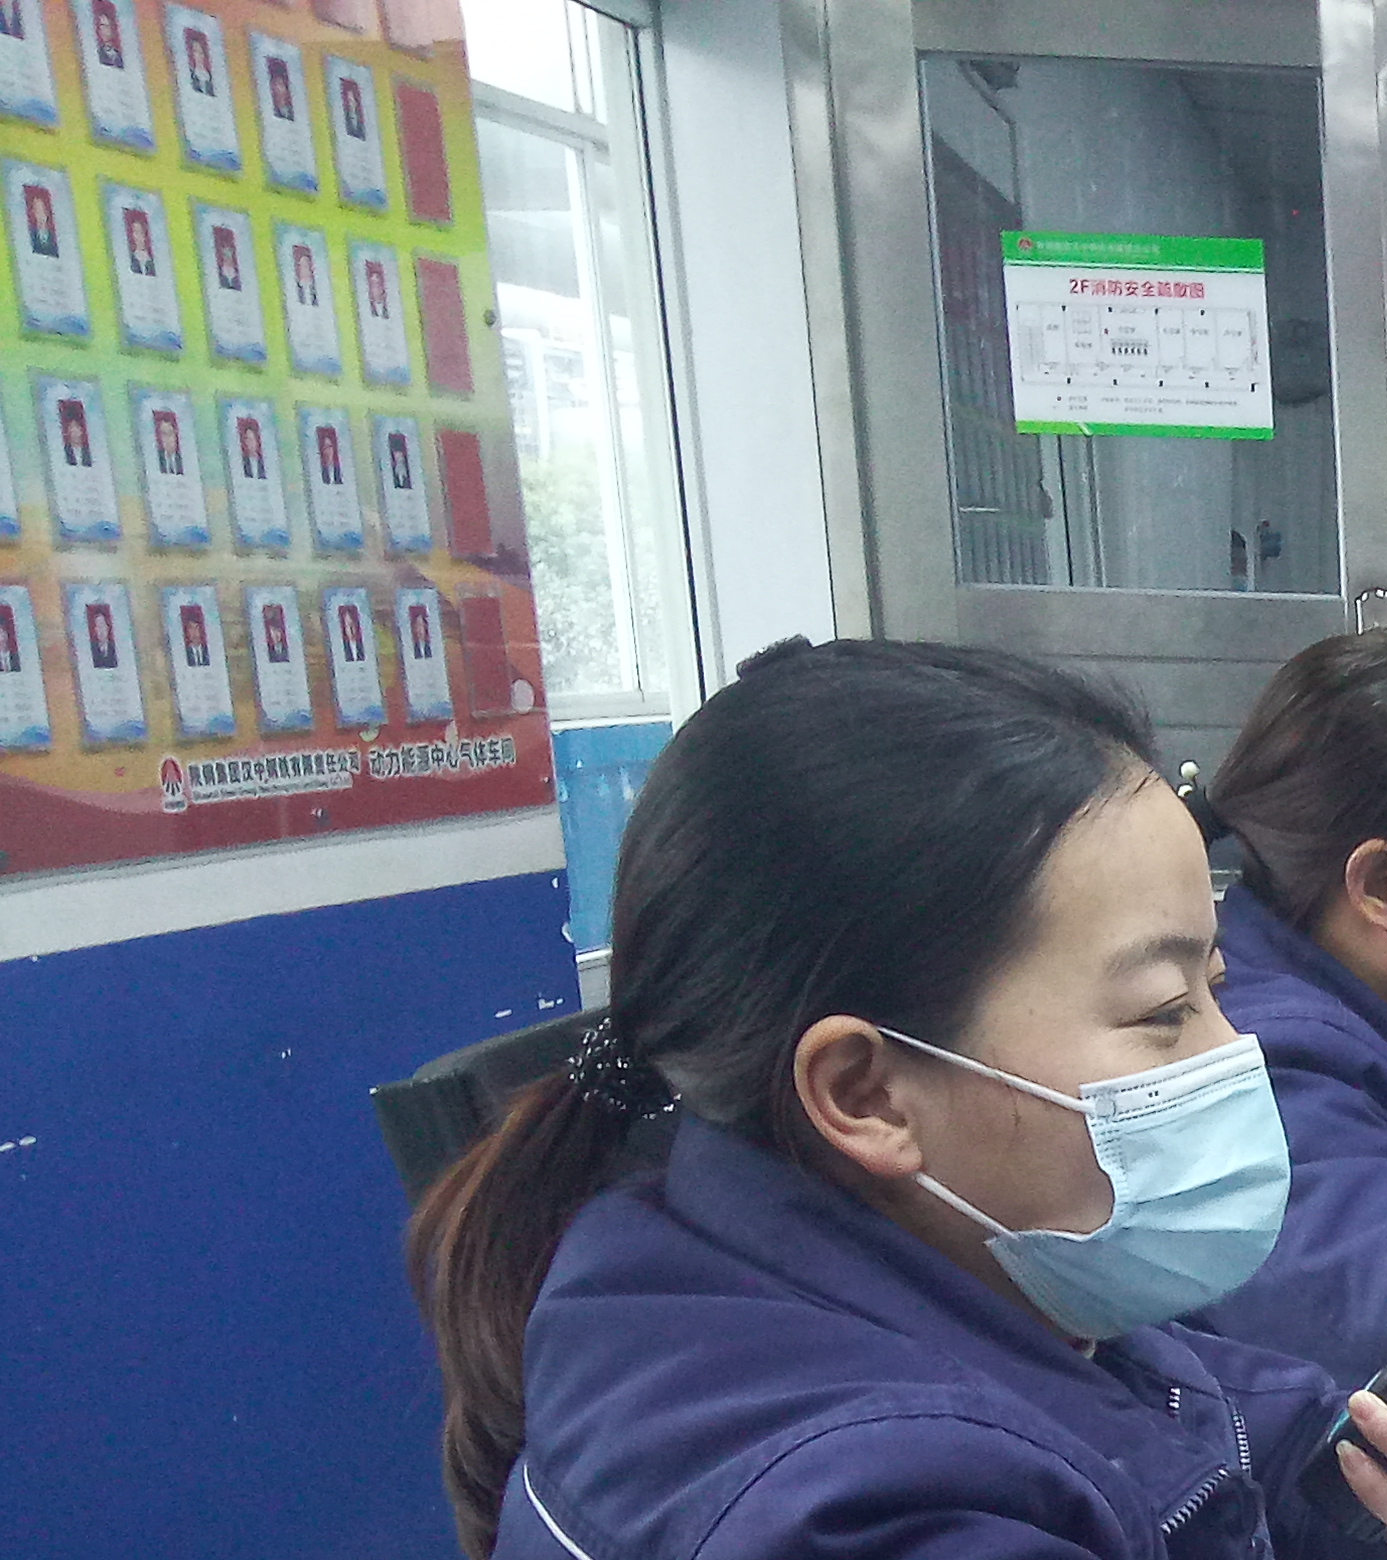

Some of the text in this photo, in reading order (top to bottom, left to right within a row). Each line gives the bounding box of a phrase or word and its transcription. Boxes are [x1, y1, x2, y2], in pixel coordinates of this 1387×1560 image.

[1069, 278, 1206, 300] 2F消防安全疏散图
